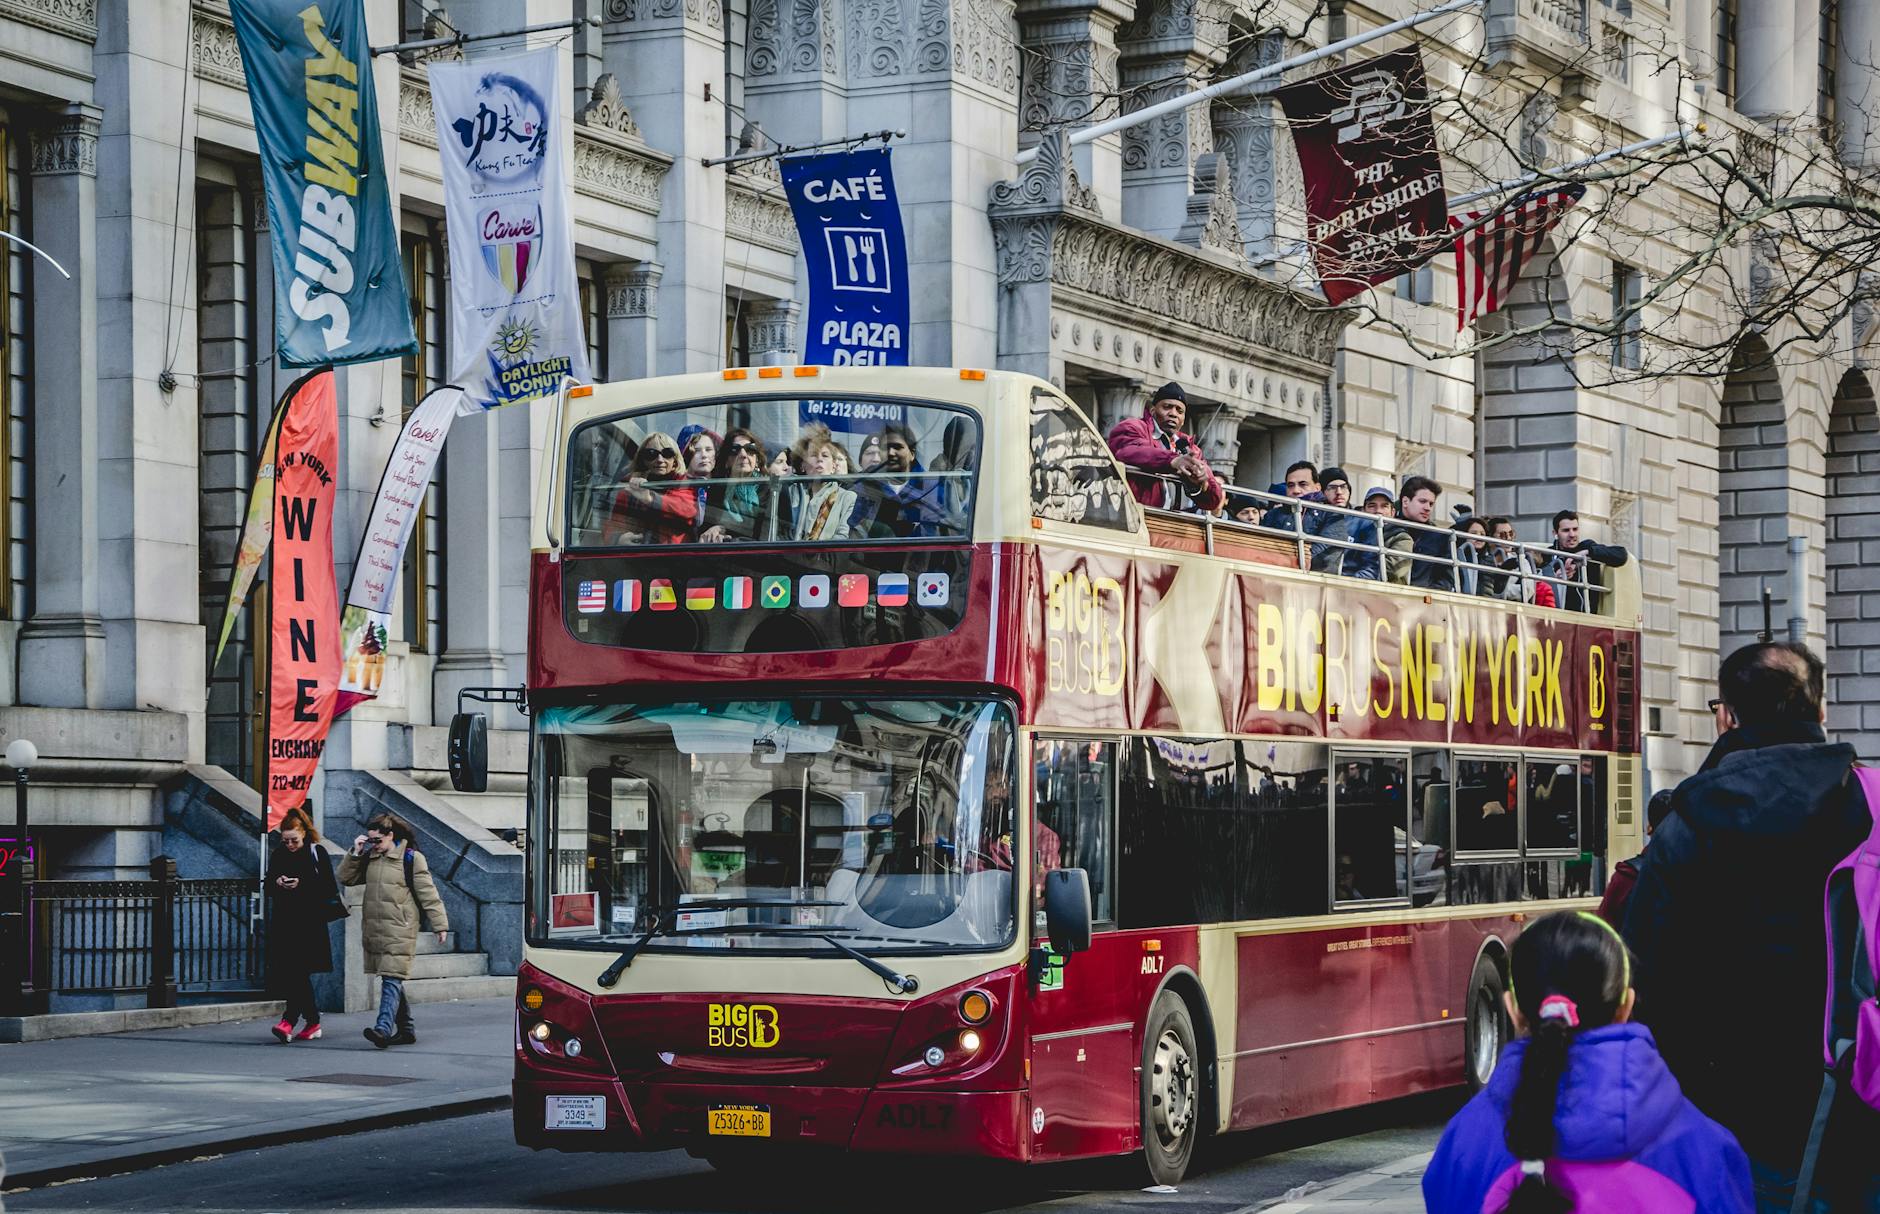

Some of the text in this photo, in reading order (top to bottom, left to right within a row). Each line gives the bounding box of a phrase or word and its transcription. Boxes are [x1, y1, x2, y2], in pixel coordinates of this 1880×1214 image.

[290, 3, 358, 351] SUBWAY
[475, 160, 500, 174] Kung
[503, 156, 515, 170] Fu
[803, 169, 886, 203] CAFÉ
[822, 320, 900, 349] PLAZA
[502, 357, 569, 383] DAYLIGHT
[833, 348, 887, 366] DELI
[300, 452, 333, 488] YORK
[281, 497, 320, 722] WINE
[1049, 570, 1091, 634] BIG
[1049, 637, 1092, 694] BUS
[1401, 621, 1477, 724] NEW
[1484, 634, 1565, 728] YORK
[709, 1004, 748, 1026] BIG
[709, 1027, 748, 1048] BUS
[565, 1110, 585, 1119] 3349
